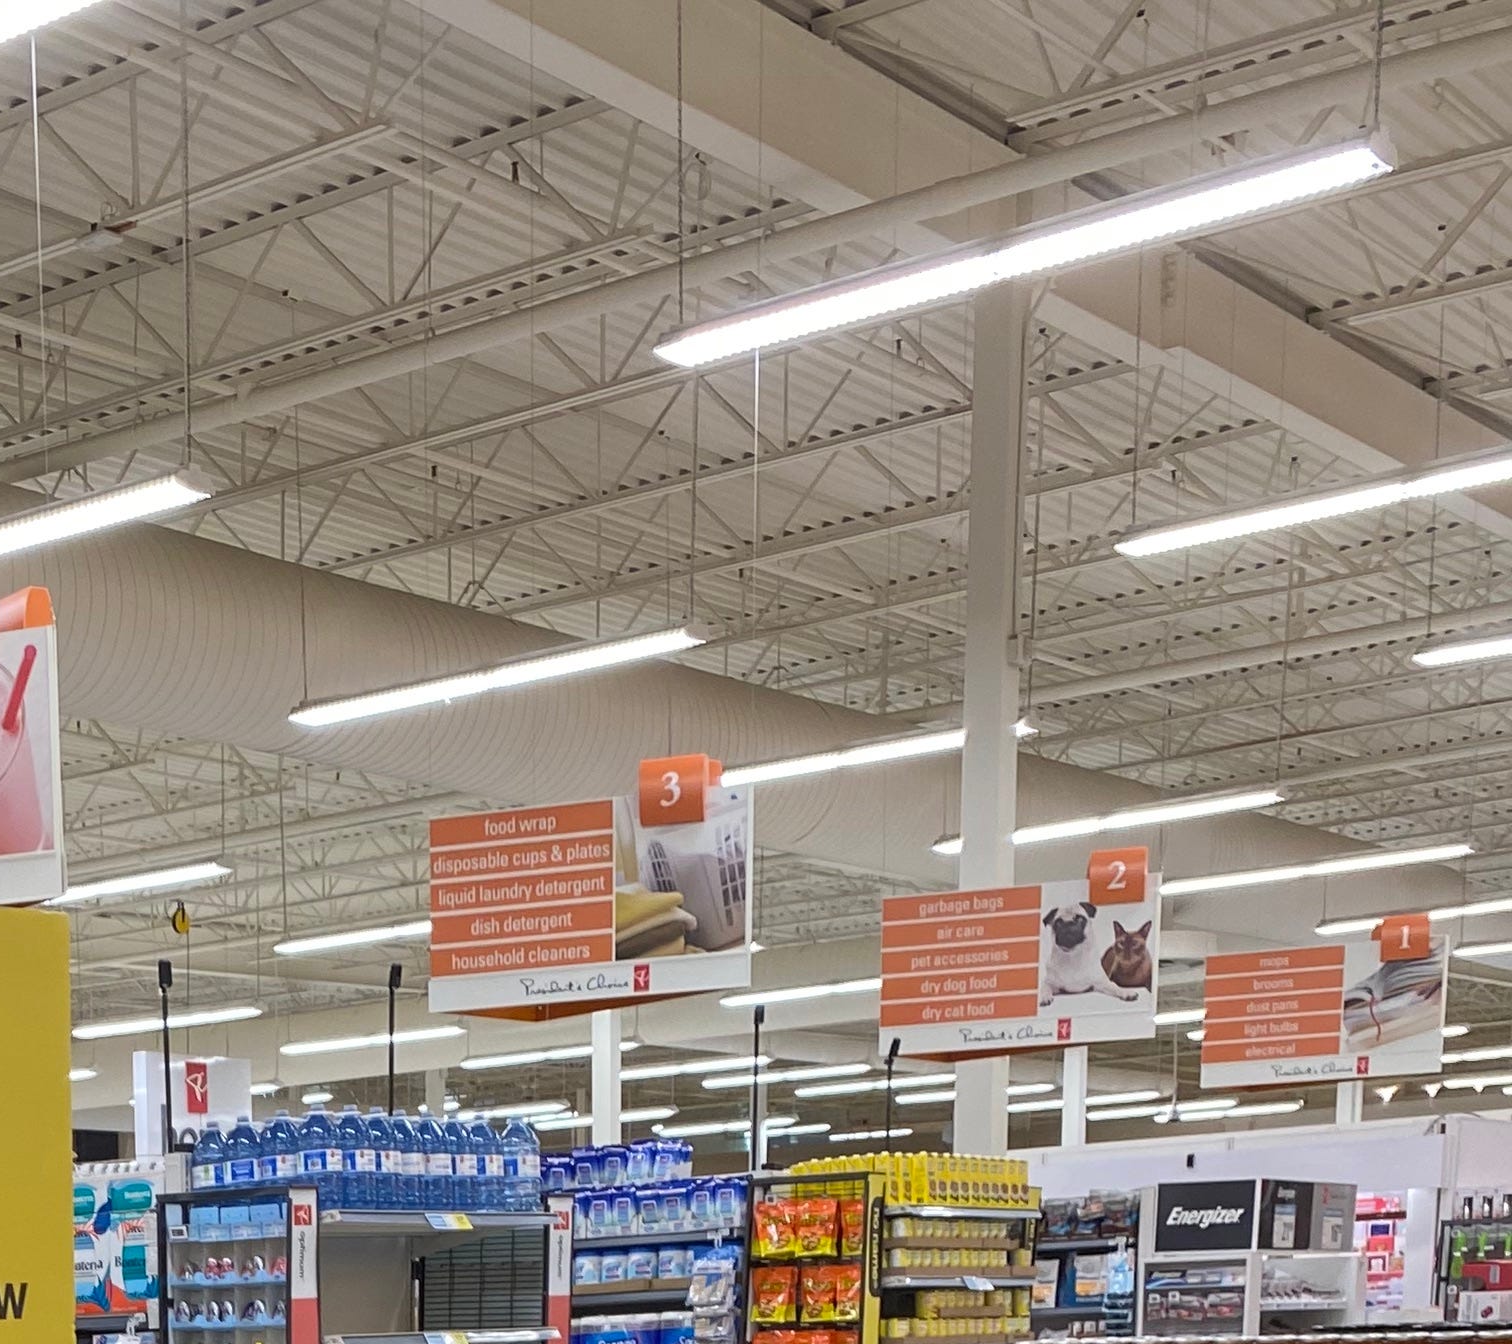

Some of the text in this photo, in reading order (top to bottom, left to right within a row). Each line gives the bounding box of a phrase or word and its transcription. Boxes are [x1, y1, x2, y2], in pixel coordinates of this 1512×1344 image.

[660, 771, 682, 807] 3
[484, 815, 557, 837] food wrap
[433, 841, 610, 875] disposable cups & plates
[1106, 860, 1127, 890] 2
[438, 876, 606, 908] liquid laundry detergent
[919, 895, 1004, 918] garbage bags
[470, 911, 573, 936] dish detergent
[936, 924, 985, 939] air care
[1399, 925, 1412, 950] 1
[451, 943, 591, 970] household cleaners
[910, 949, 1009, 970] pet accessories
[920, 974, 997, 996] dry dog food
[921, 1001, 995, 1021] dry cat food
[1166, 1205, 1245, 1227] Energizer
